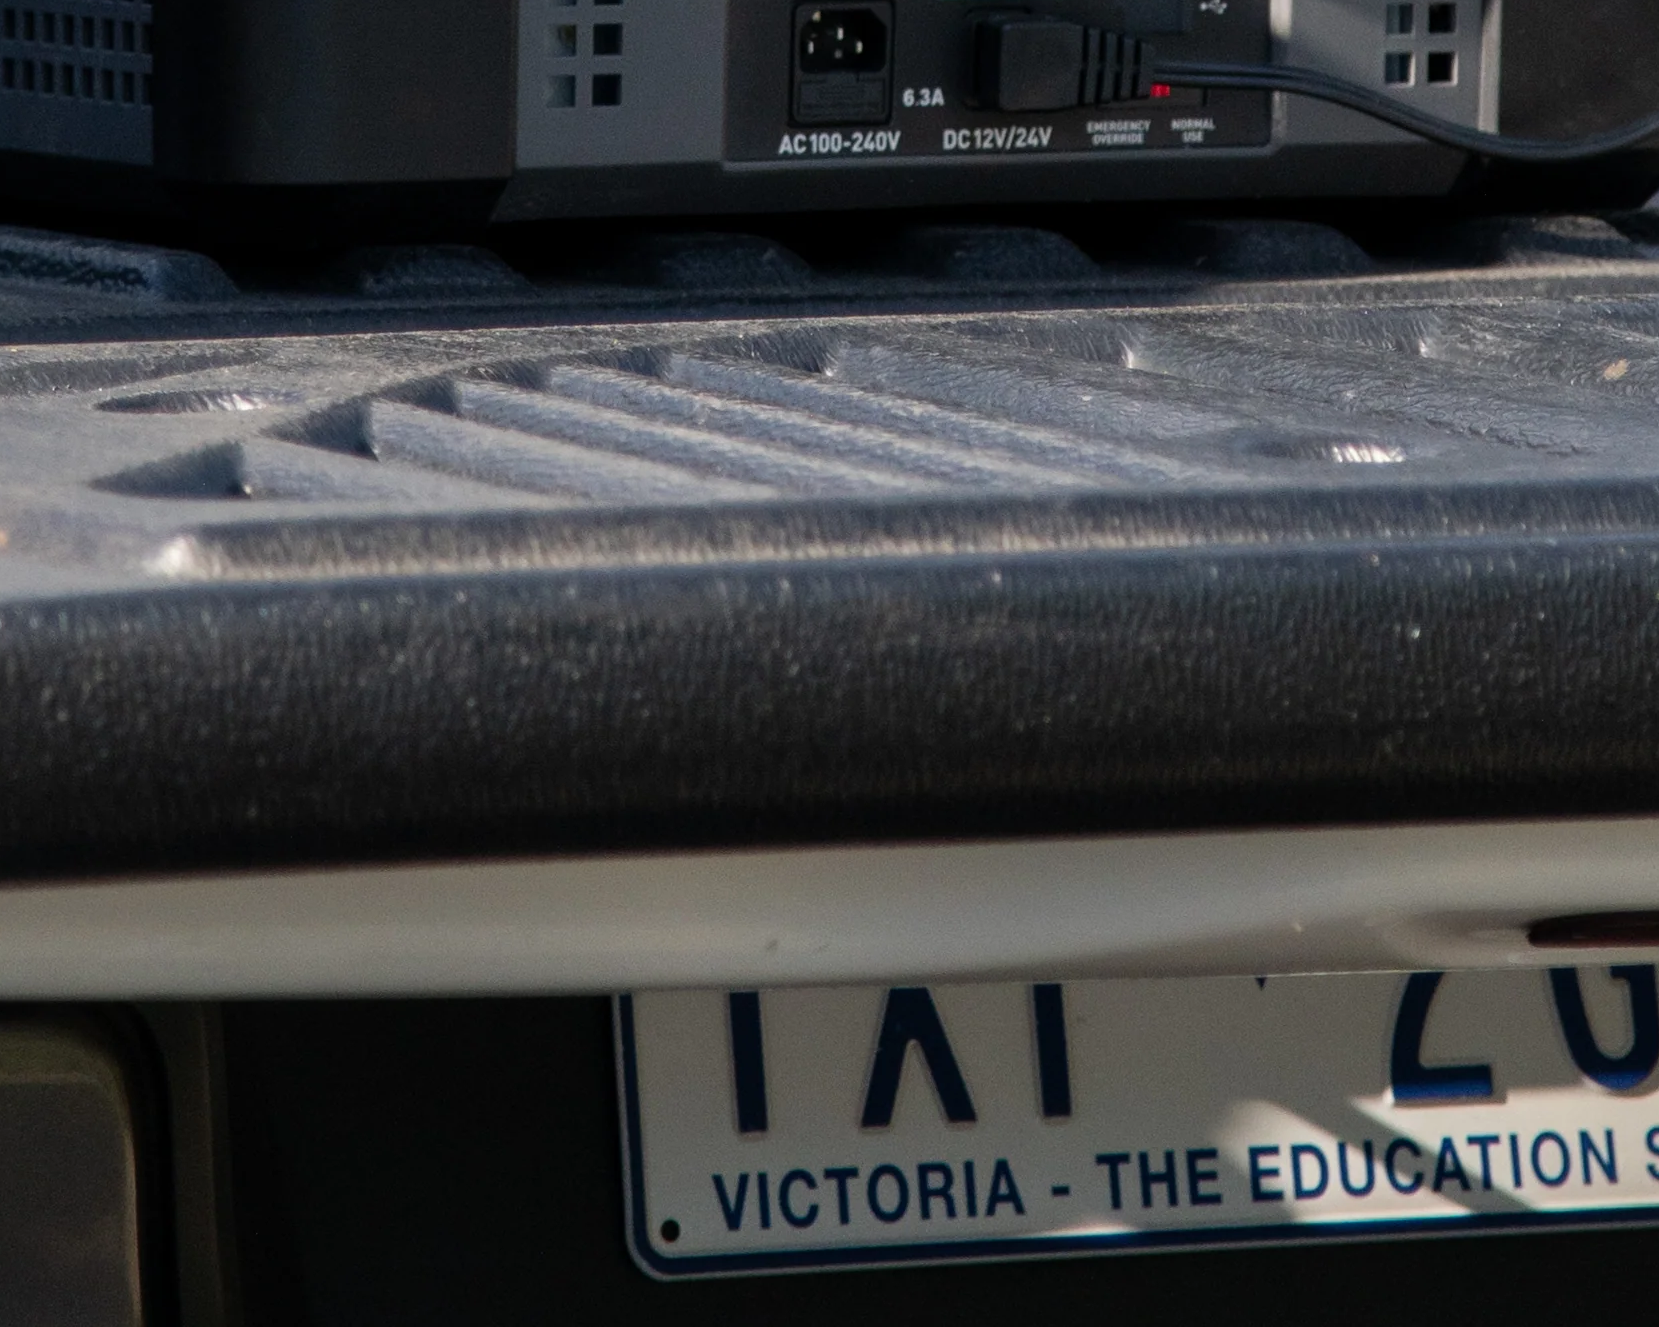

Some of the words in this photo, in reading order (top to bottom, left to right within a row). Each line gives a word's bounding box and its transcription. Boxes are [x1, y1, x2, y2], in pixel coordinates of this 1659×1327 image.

[902, 88, 945, 107] 6.3A
[1086, 119, 1151, 133] EMERGENCY
[1171, 118, 1215, 131] NORMAL
[1092, 132, 1144, 145] OVERRIDE
[1182, 130, 1204, 143] USE
[712, 1158, 1026, 1231] VICTORIA
[1095, 1148, 1222, 1210] THE
[1249, 1128, 1619, 1203] EDUCATION
